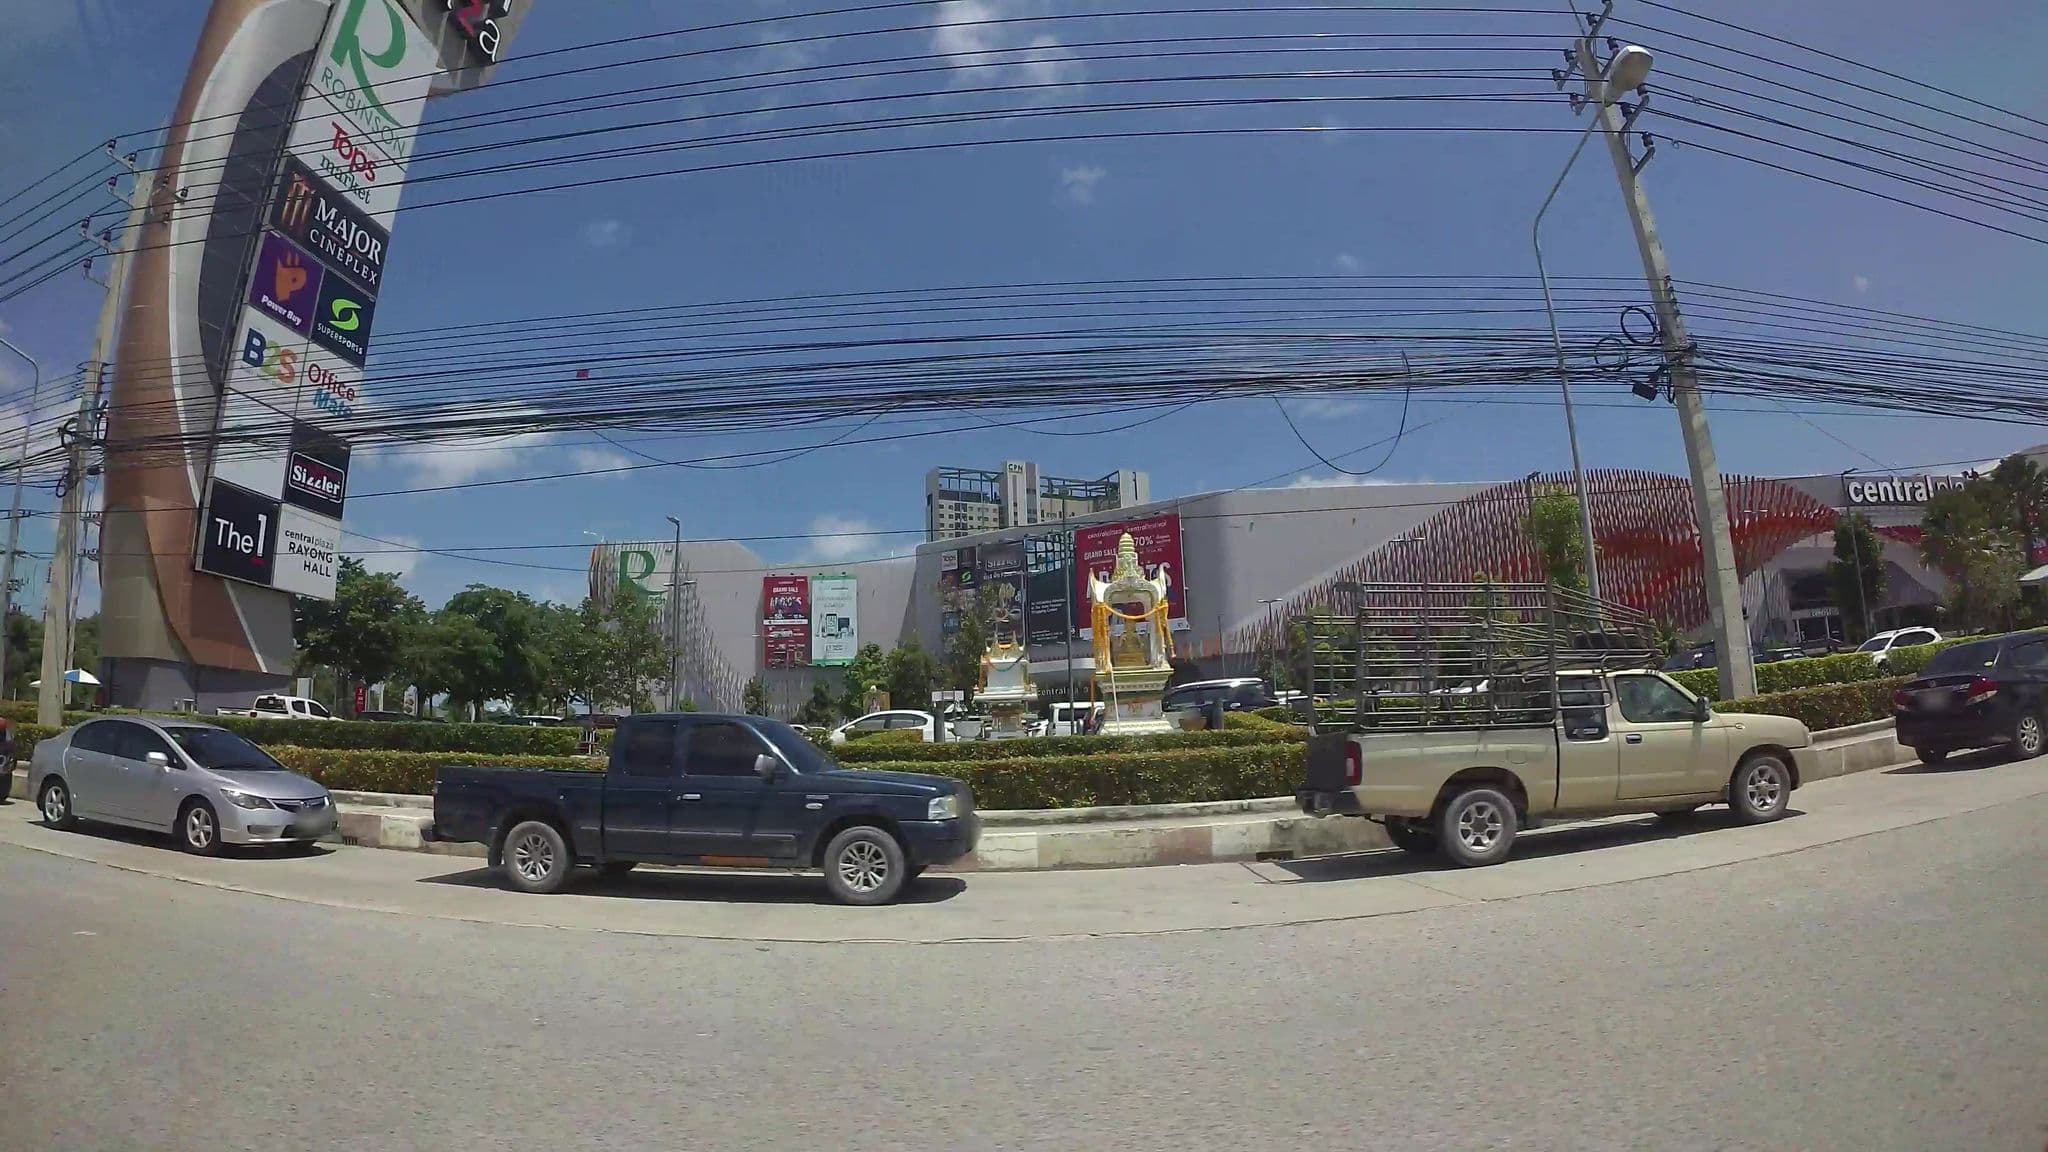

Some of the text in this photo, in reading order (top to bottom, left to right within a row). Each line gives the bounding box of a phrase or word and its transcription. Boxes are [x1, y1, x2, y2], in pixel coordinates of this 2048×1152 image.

[320, 66, 406, 156] ROBINSON
[331, 120, 376, 182] Tops
[319, 153, 371, 204] market
[314, 197, 382, 265] MAJOR
[309, 228, 378, 285] CINEPLEX
[261, 294, 303, 326] Power Buy
[242, 327, 298, 384] B2S
[308, 362, 356, 402] Office
[292, 465, 341, 496] Sizzler
[1008, 463, 1024, 472] CPN
[215, 517, 254, 554] The
[288, 541, 333, 564] RAYONG
[303, 560, 331, 577] HALL
